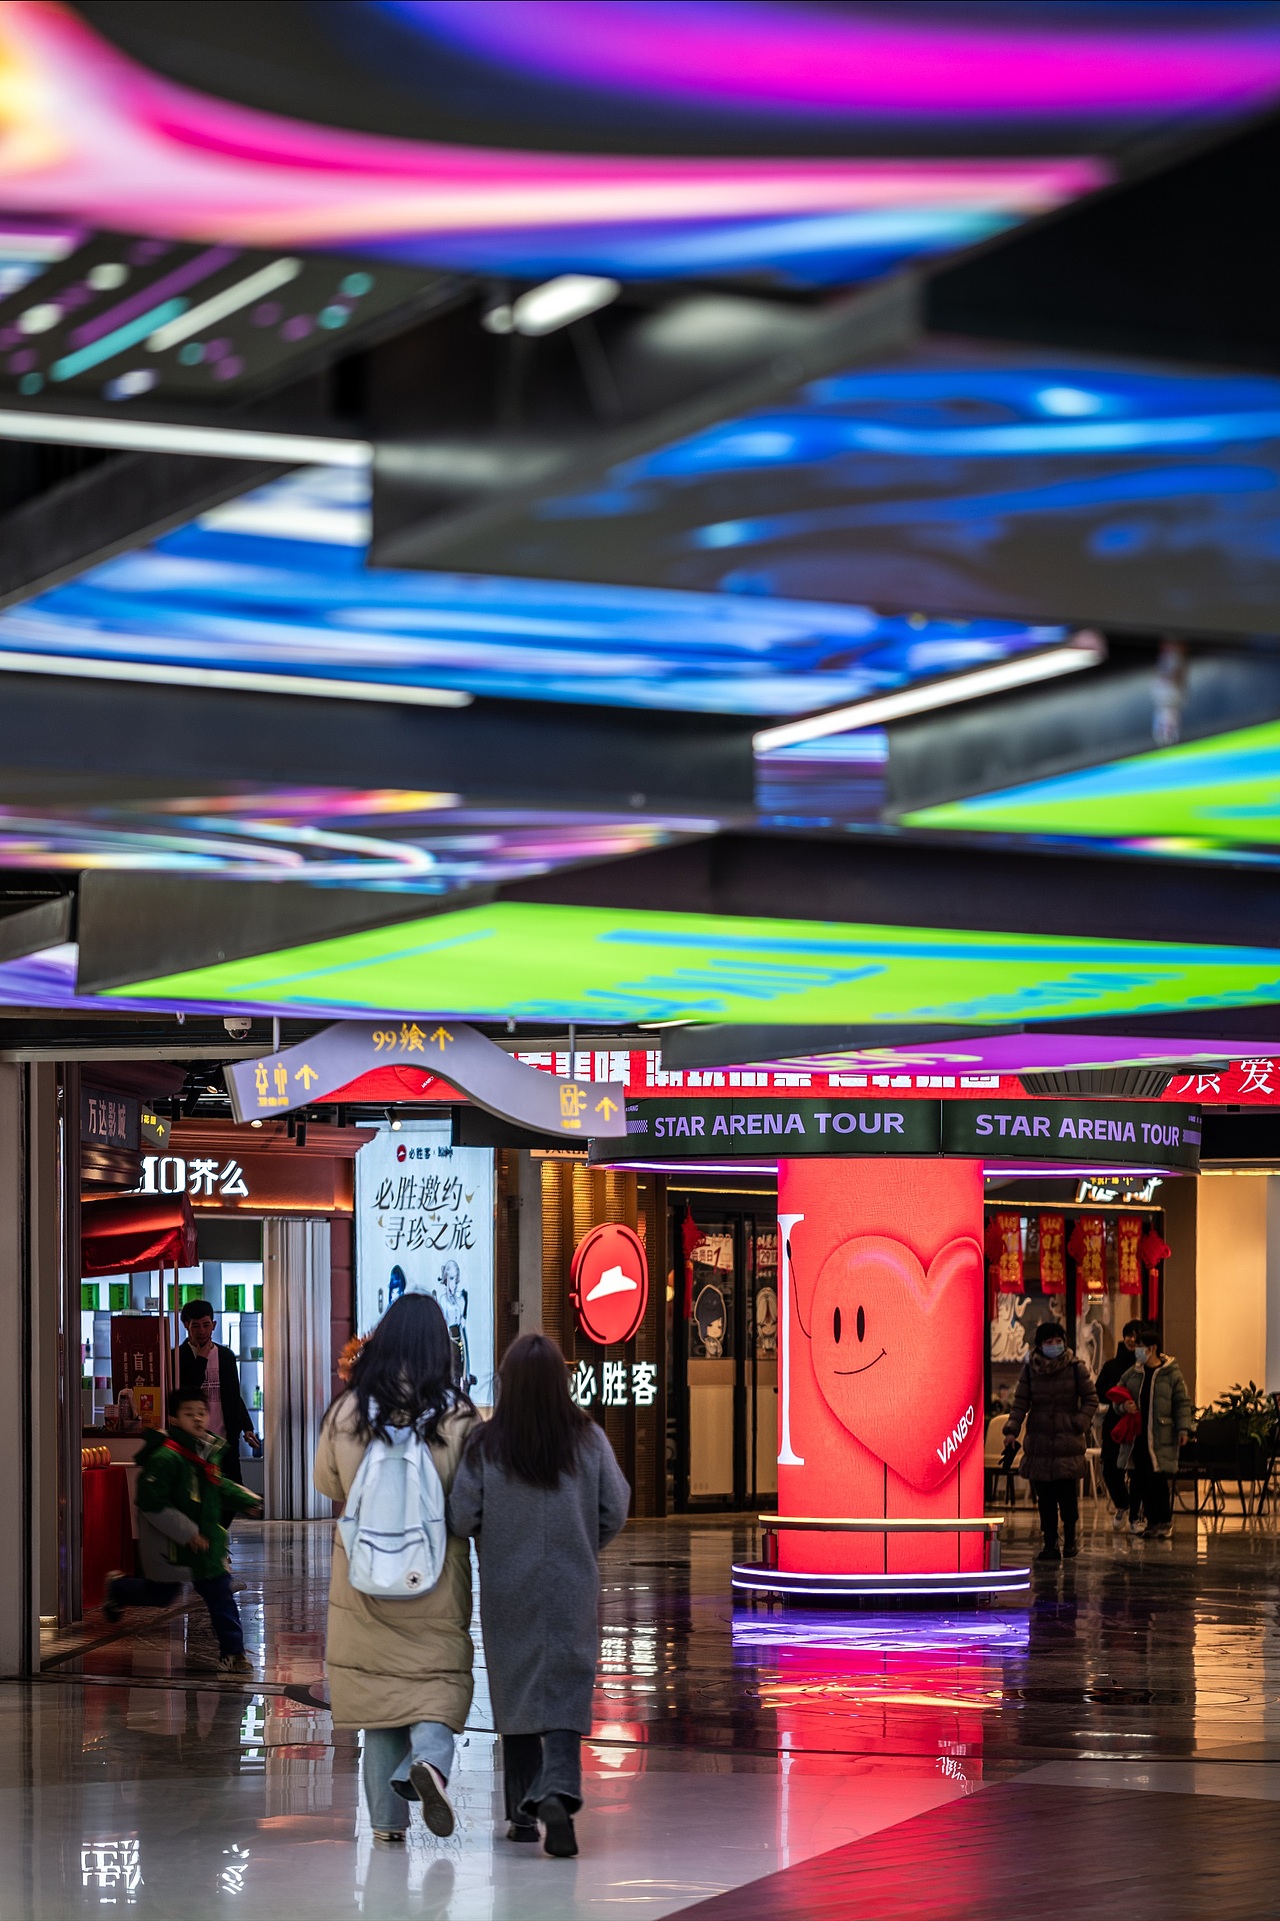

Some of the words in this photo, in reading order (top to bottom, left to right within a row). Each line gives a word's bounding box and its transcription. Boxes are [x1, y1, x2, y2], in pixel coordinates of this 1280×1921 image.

[88, 1098, 126, 1140] 万达影城
[141, 1114, 157, 1126] 花园
[654, 1115, 706, 1138] STAR
[711, 1113, 806, 1136] ARENA
[813, 1112, 905, 1134] TOUR
[975, 1114, 1051, 1138] STAR
[1057, 1117, 1137, 1143] ARENA
[1140, 1122, 1180, 1147] TOUR
[371, 1174, 464, 1212] 必胜邀约
[385, 1213, 477, 1251] 寻珍之旅
[570, 1359, 659, 1407] 必胜客
